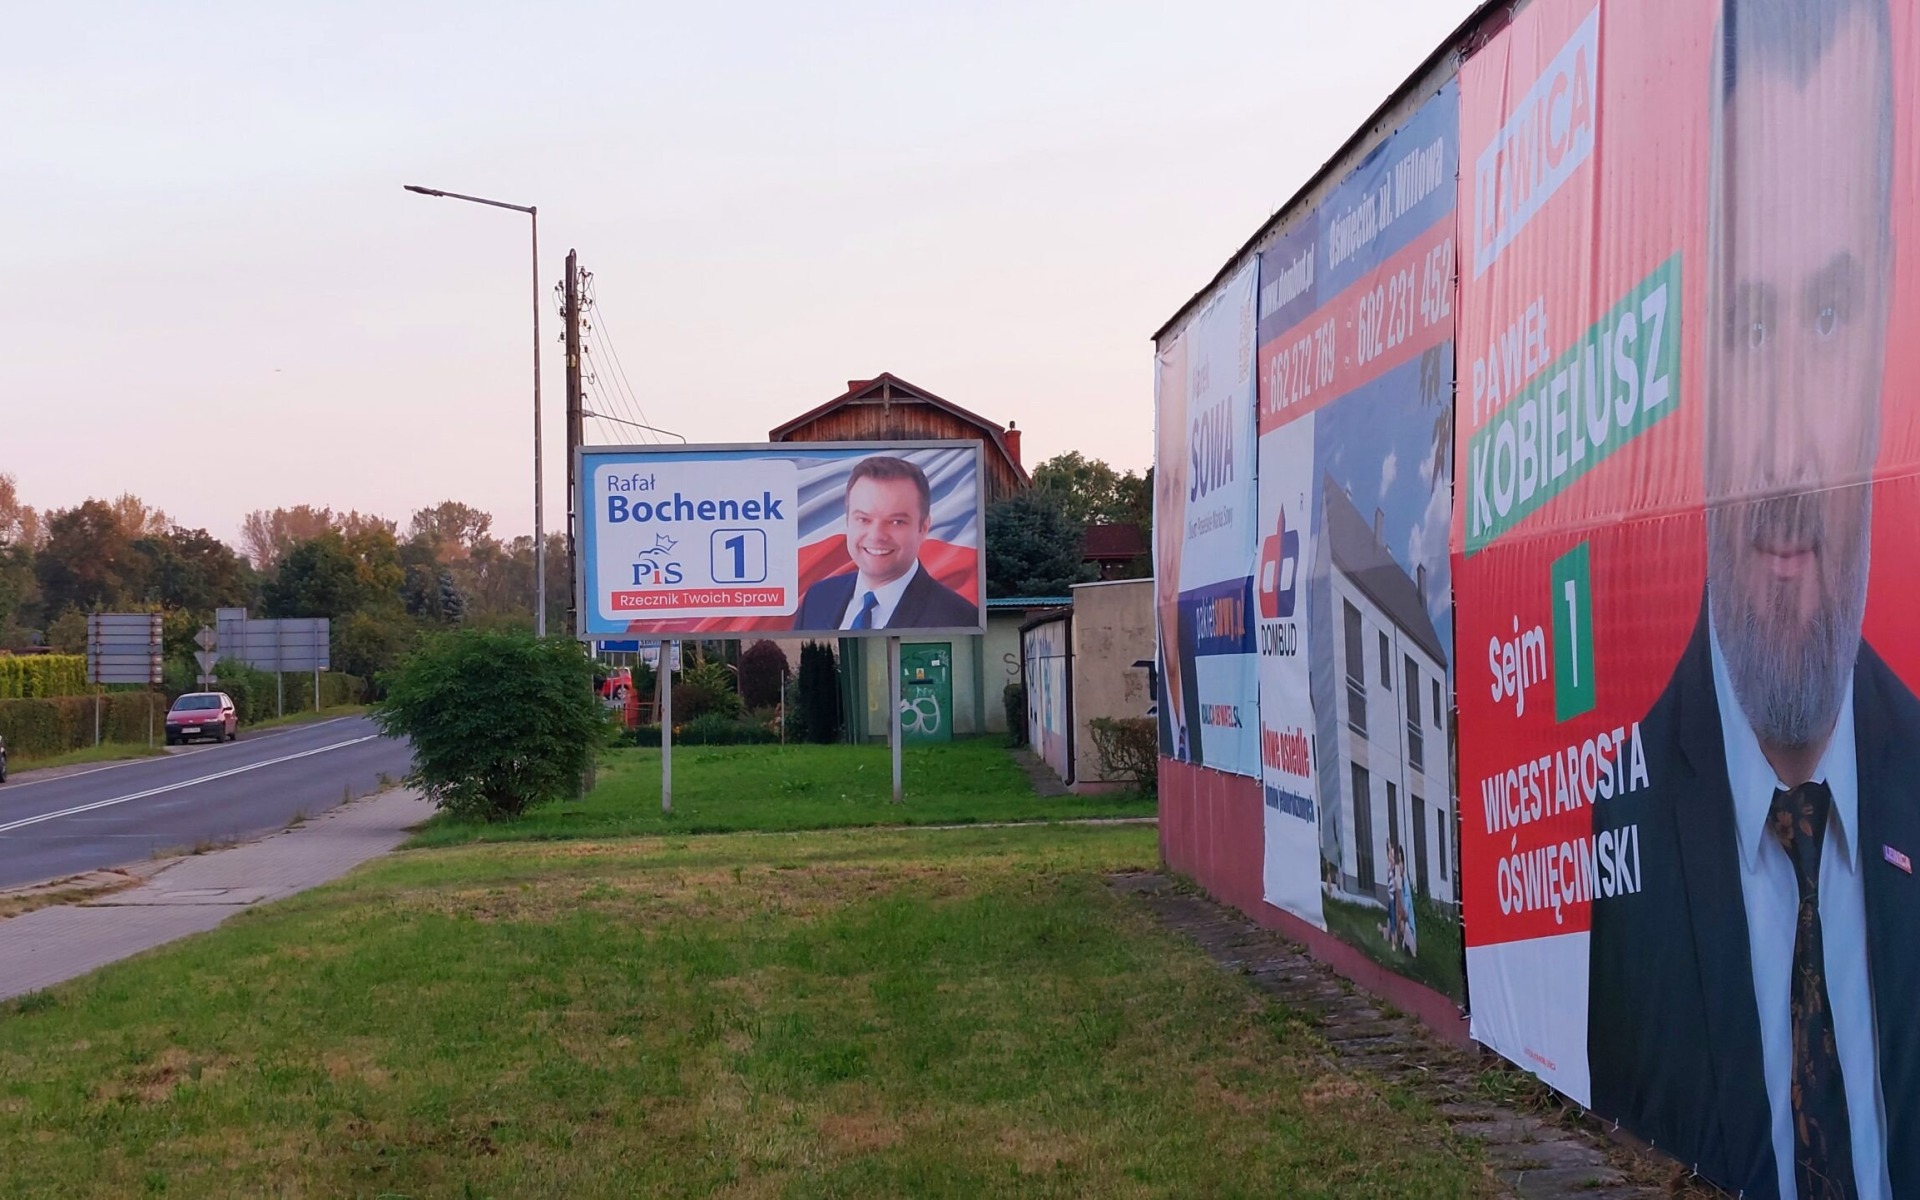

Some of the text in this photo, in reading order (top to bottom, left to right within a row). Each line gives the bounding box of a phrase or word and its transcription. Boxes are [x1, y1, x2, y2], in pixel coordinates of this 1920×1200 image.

[1329, 193, 1379, 271] Oświęcim,
[1379, 172, 1393, 229] ul.
[1395, 137, 1443, 217] Willowa
[1270, 238, 1450, 415] 662 272 769 602 231 452
[1473, 294, 1549, 427] PAWEŁ
[1190, 394, 1233, 503] SOWA
[1473, 282, 1669, 537] KOBIELUSZ
[607, 473, 655, 492] Rafał
[607, 492, 784, 523] Bochenek
[620, 590, 779, 607] Rzecznik Twoich Spraw
[632, 563, 683, 585] PiS
[724, 535, 745, 579] 1
[1261, 621, 1296, 656] DOMBUD
[1489, 580, 1578, 718] Sejm 1
[1280, 726, 1310, 779] osiedle
[1481, 721, 1650, 834] WICESTAROSTA
[1498, 823, 1642, 925] OŚWIĘCIMSKI
